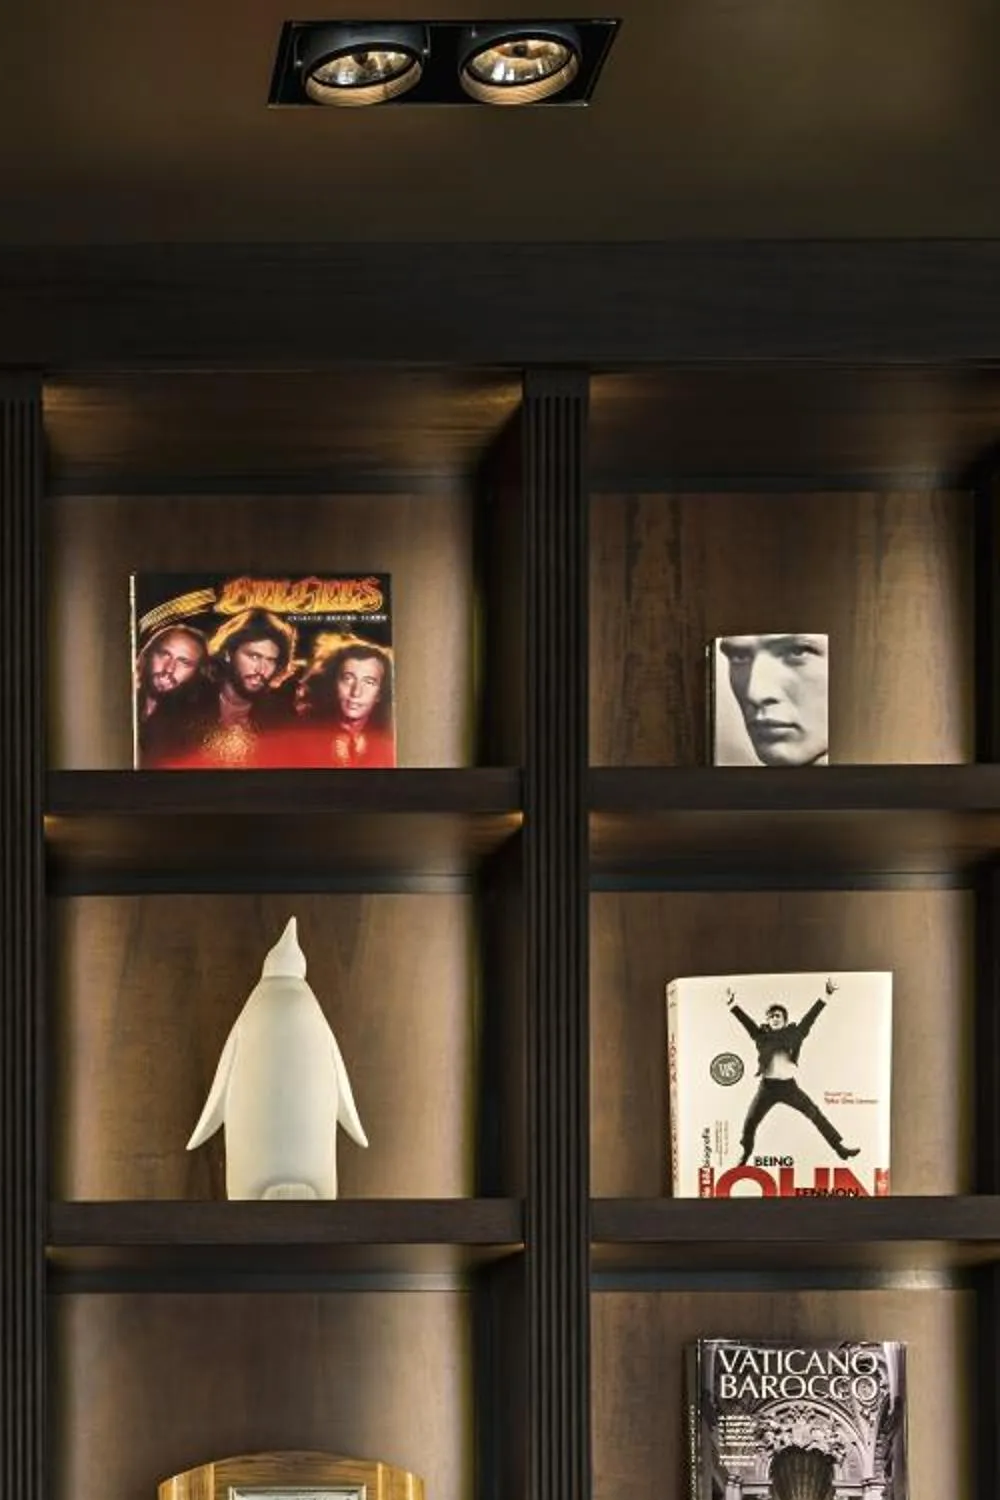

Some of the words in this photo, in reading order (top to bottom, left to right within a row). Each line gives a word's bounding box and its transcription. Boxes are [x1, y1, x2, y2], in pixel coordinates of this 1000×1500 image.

[754, 1155, 795, 1167] BEING
[718, 1350, 878, 1375] VATICANO
[720, 1375, 878, 1399] BAROCCO
